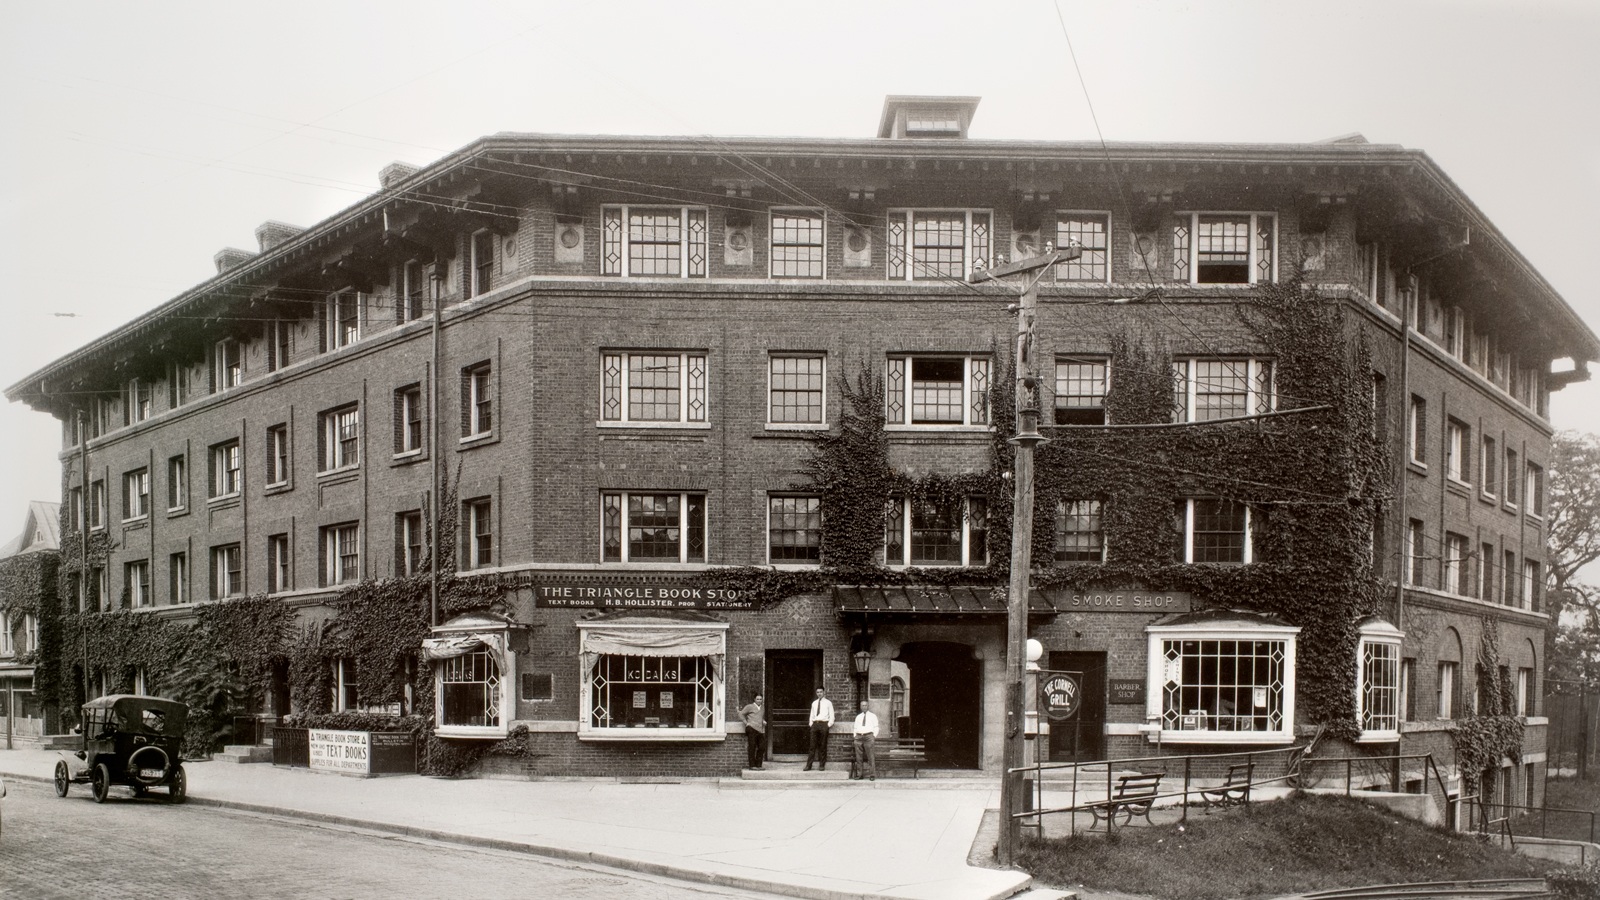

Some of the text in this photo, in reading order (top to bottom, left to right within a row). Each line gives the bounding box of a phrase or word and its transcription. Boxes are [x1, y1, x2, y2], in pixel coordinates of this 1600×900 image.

[542, 586, 757, 600] THE TRIANGLE BOOK STO
[624, 599, 675, 607] HOLLISTER.
[1072, 595, 1123, 606] SMOKE
[628, 670, 677, 680] KODAKS
[1044, 678, 1076, 698] THE CORNELL
[1114, 683, 1142, 691] BARBER
[1050, 693, 1070, 706] GRILL
[1118, 690, 1136, 698] SHOP
[316, 733, 360, 744] TRIANGLE BOOK STORE
[326, 744, 367, 760] TEXT BOOKS
